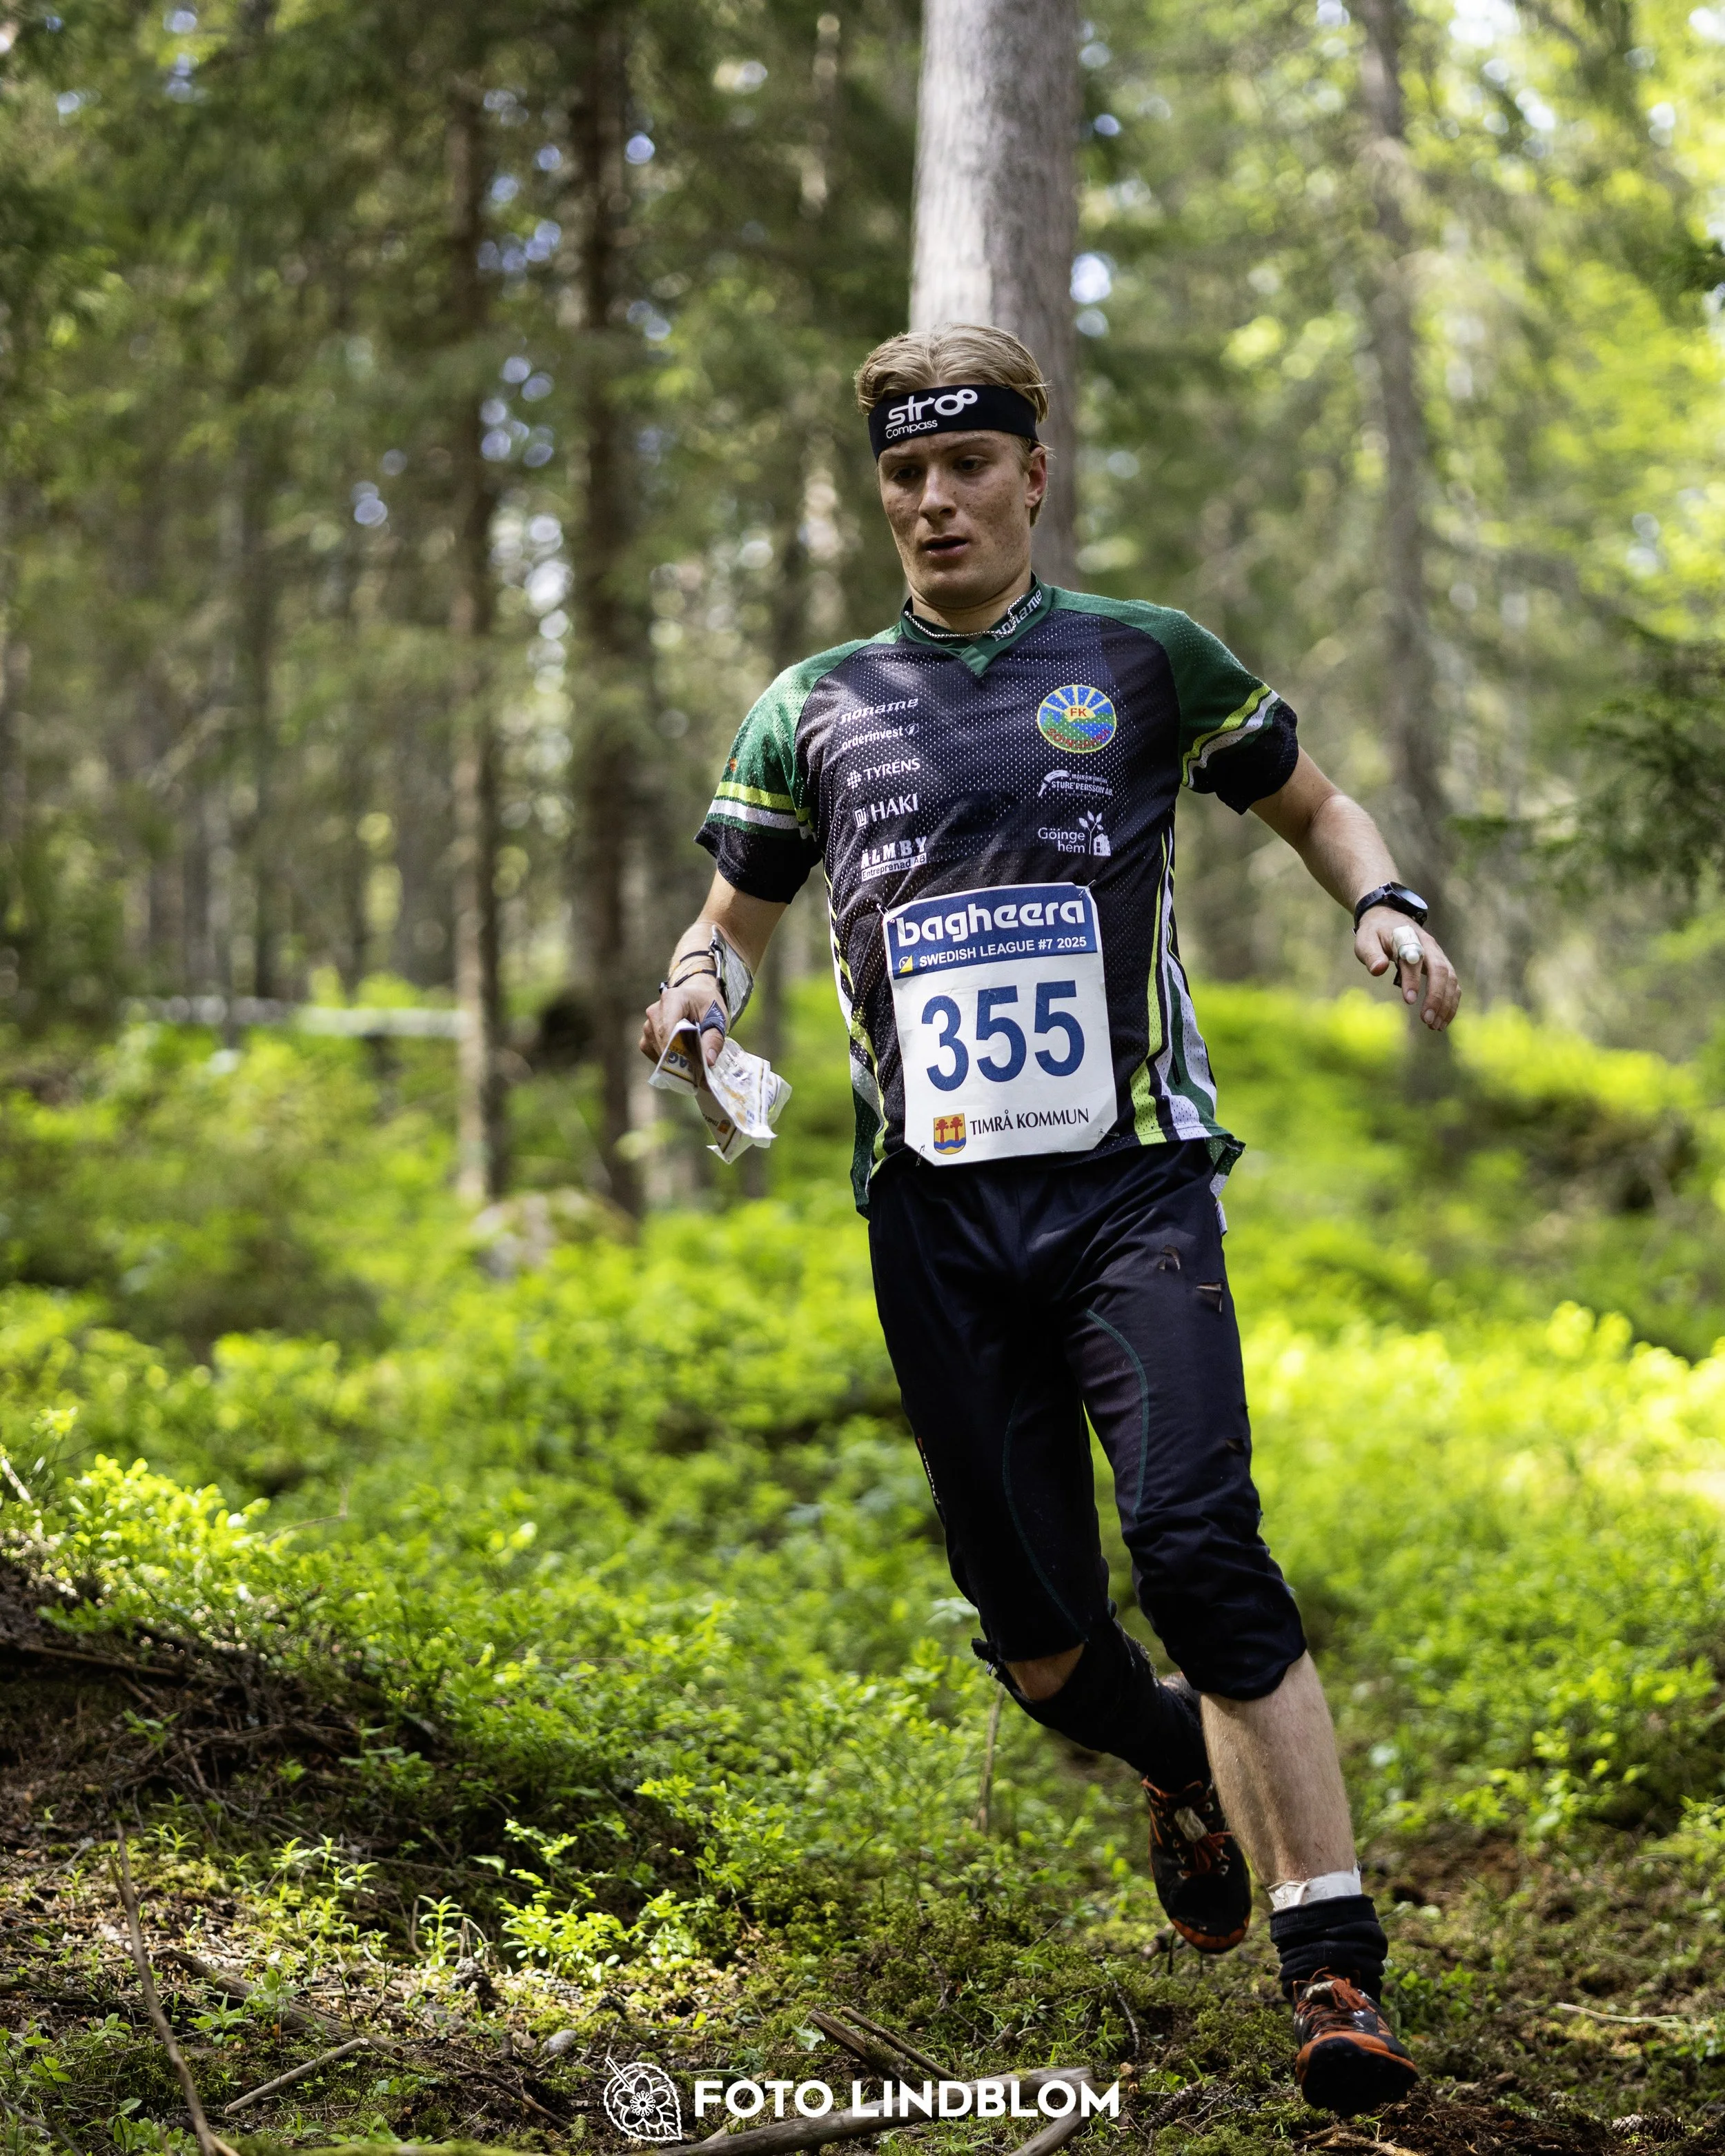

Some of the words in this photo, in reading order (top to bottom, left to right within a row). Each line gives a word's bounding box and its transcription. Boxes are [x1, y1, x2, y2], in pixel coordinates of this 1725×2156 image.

[886, 419, 938, 439] Compass
[839, 698, 918, 724] noname
[1070, 707, 1087, 717] FK
[842, 726, 904, 751] orderinvest
[1052, 781, 1074, 789] STURE
[1076, 782, 1105, 793] PERSSON
[870, 793, 919, 822] HAKI
[1038, 827, 1085, 843] Göinge
[1058, 840, 1085, 853] hem
[861, 835, 927, 869] ÄLMBY
[862, 859, 911, 880] Entreprenad
[914, 855, 925, 865] AB
[896, 900, 1085, 947] bagheera
[920, 947, 976, 967] SWEDISH
[980, 940, 1035, 958] LEAGUE
[1038, 938, 1053, 950] #7
[1057, 936, 1087, 949] 2025
[921, 980, 1085, 1091] 355
[970, 1109, 1013, 1135] TIMRÅ
[1016, 1108, 1090, 1129] KOMMUN
